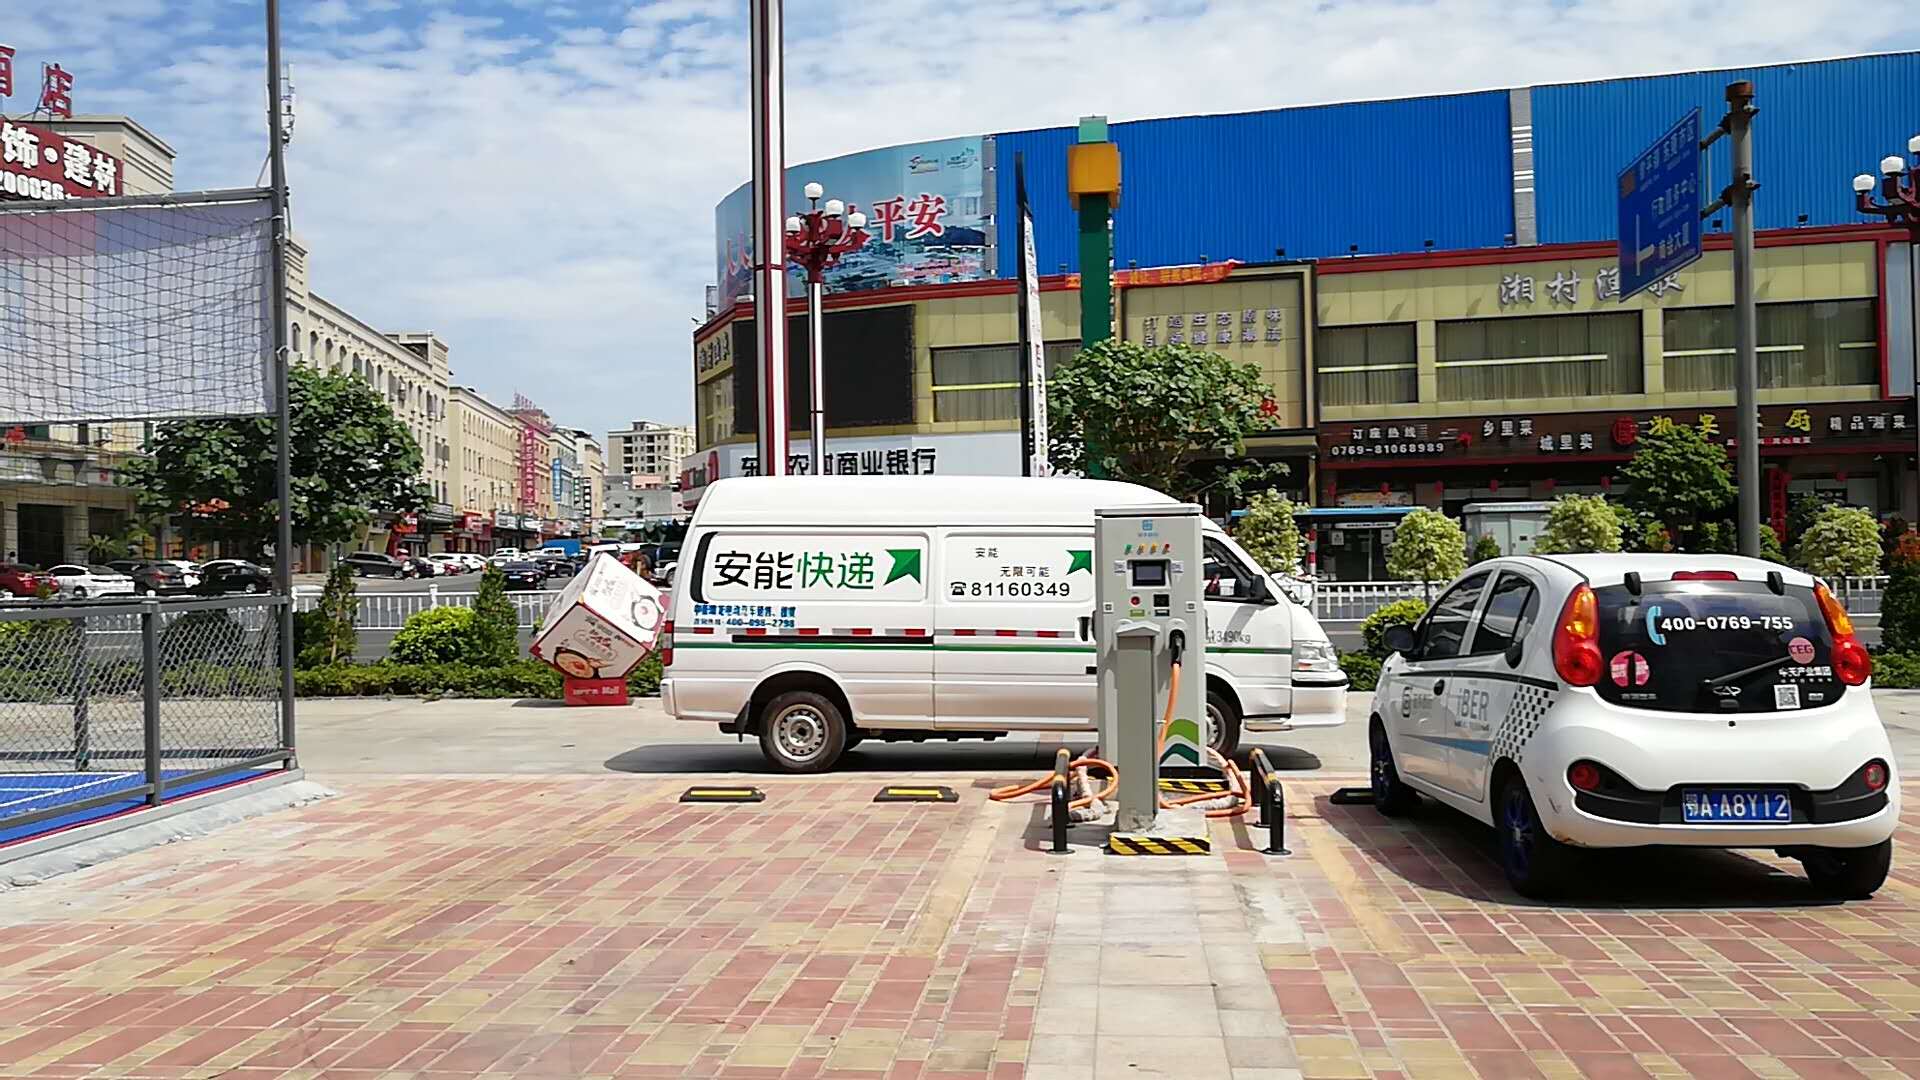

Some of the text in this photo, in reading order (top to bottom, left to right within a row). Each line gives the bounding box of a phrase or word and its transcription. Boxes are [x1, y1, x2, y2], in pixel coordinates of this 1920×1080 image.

[1331, 443, 1444, 456] 0769-81068989
[975, 547, 999, 558] 安能
[713, 551, 875, 589] 安能快递
[1000, 566, 1050, 577] 无限可能
[971, 582, 1070, 597] 81160349
[1661, 616, 1794, 631] 400-0769-755
